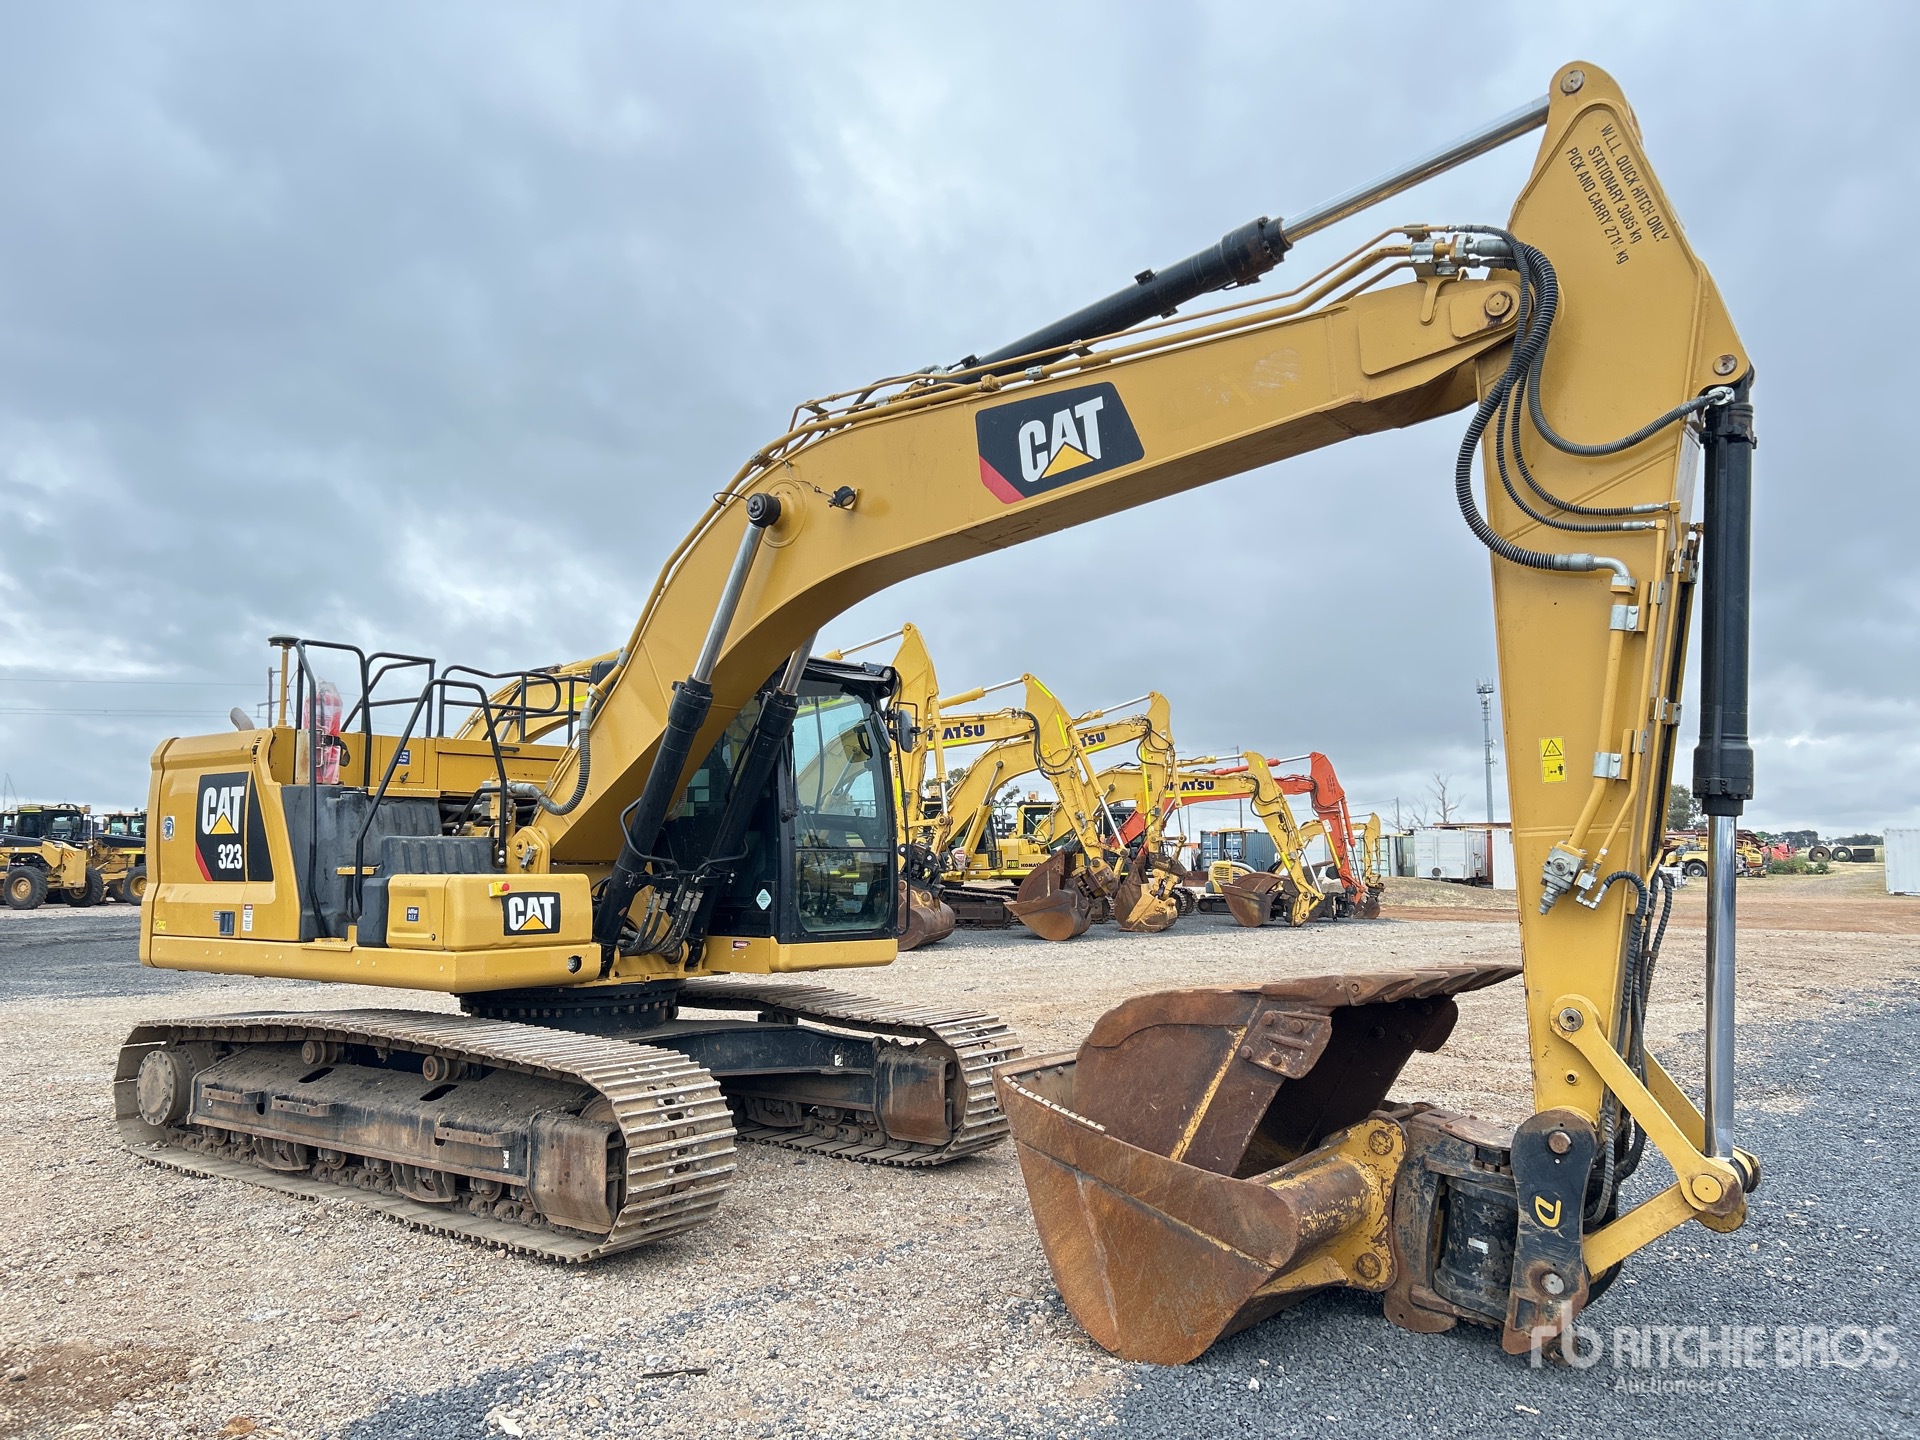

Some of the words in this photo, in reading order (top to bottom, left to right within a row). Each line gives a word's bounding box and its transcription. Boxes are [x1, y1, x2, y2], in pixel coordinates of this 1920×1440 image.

[1566, 146, 1586, 172] PICK
[1577, 170, 1596, 193] AND
[1588, 192, 1613, 226] CARRY
[1588, 145, 1626, 204] STATIONARY
[1616, 155, 1640, 187] QUICK
[1631, 185, 1656, 218] HITCH
[1647, 215, 1670, 242] ONLY
[1018, 395, 1104, 483] CAT
[202, 785, 245, 835] CAT
[218, 844, 243, 869] 323
[508, 896, 555, 931] CAT
